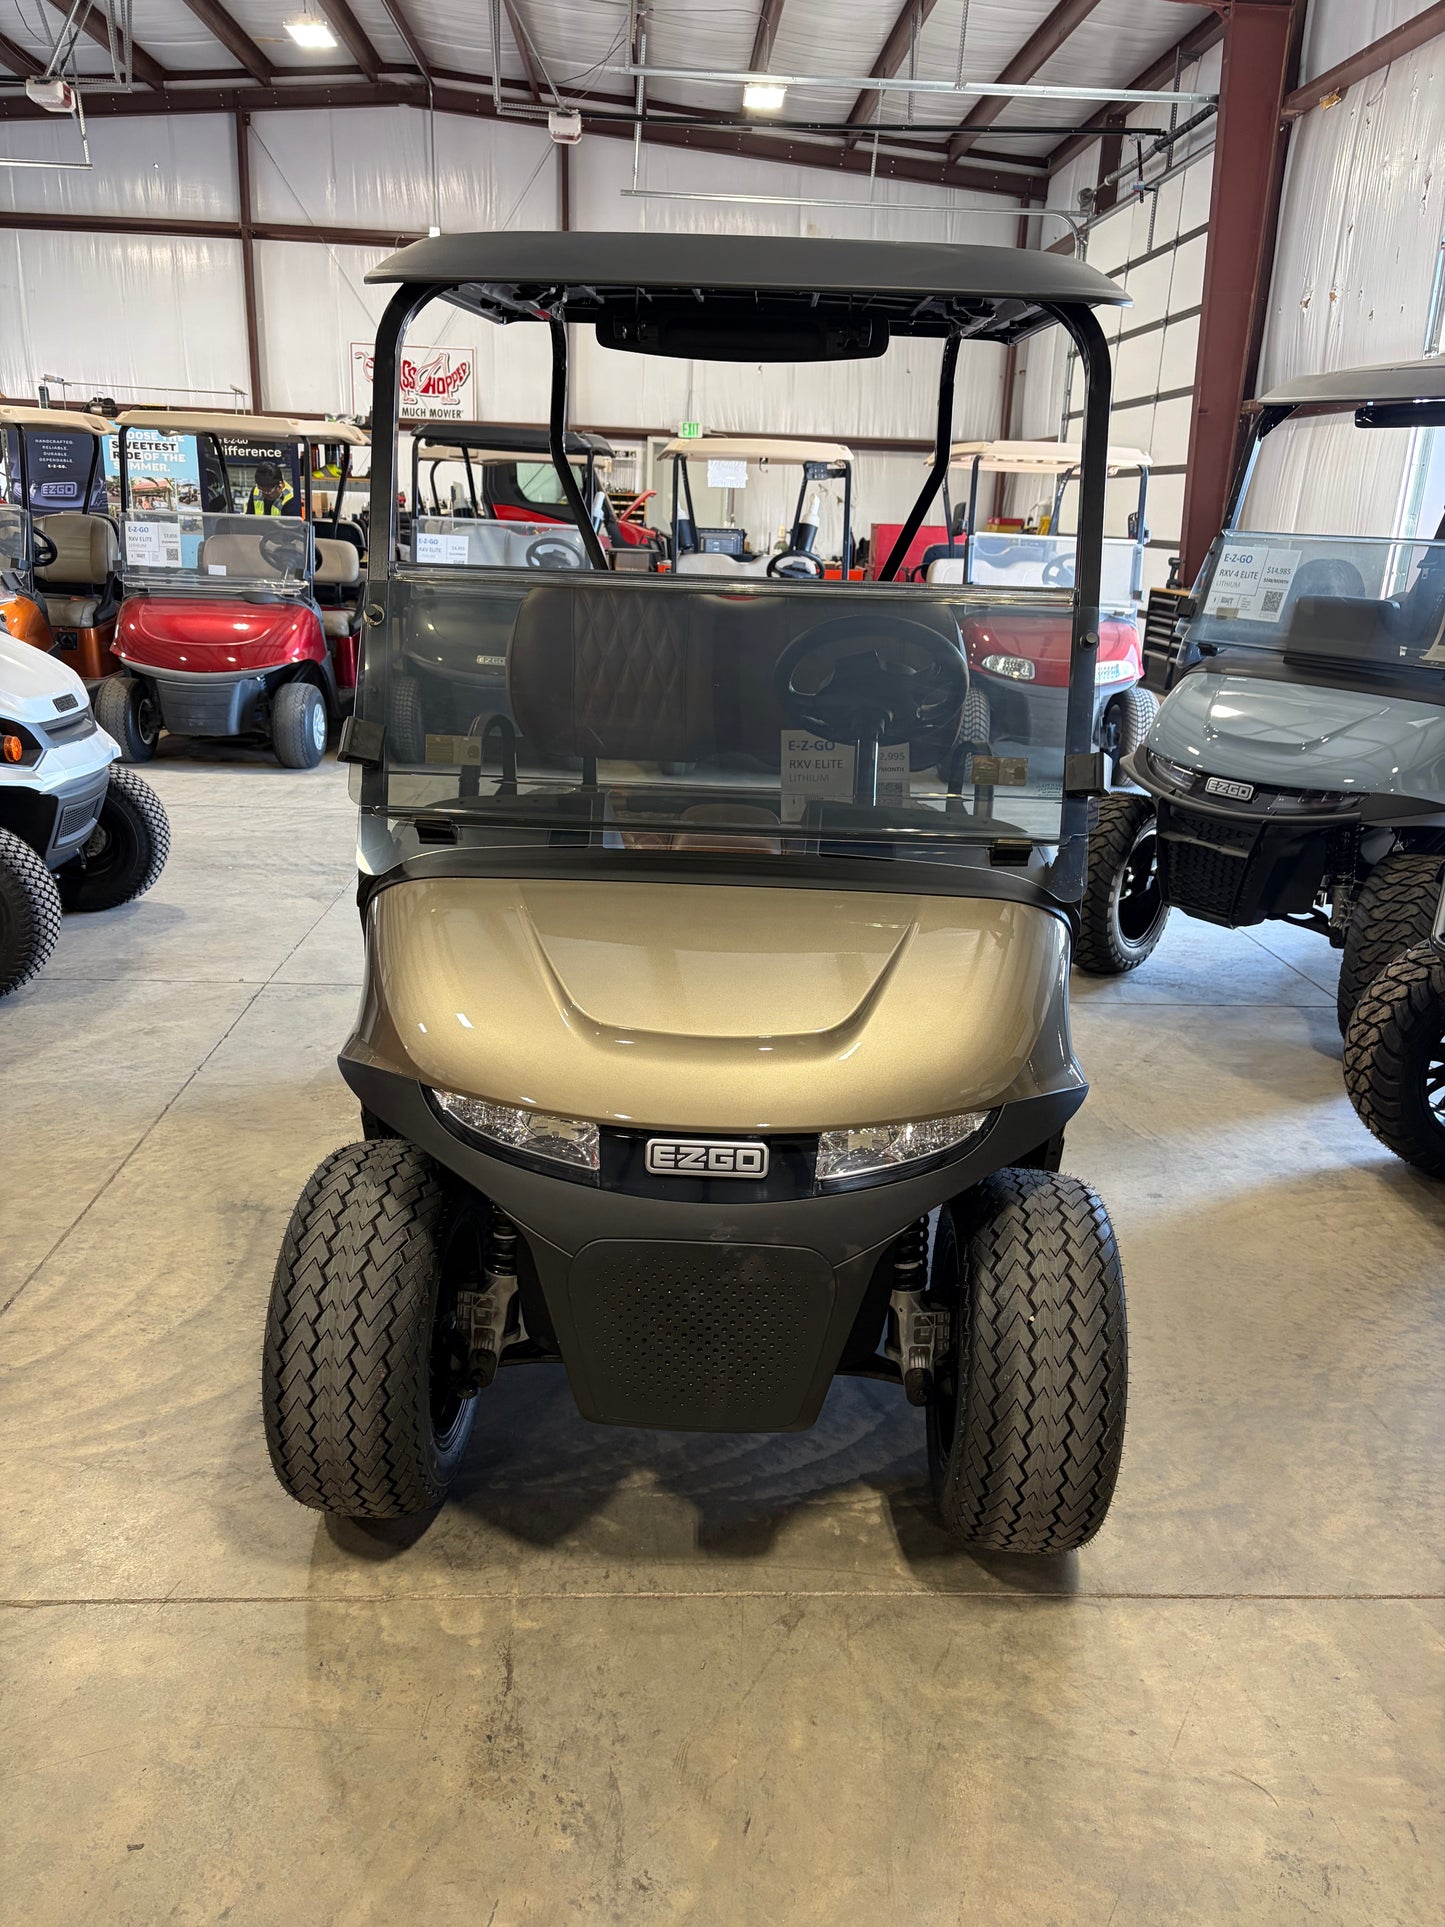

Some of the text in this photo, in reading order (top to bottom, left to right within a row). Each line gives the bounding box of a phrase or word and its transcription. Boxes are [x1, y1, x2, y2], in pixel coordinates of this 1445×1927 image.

[402, 408, 461, 418] MUCH MOWER
[682, 422, 700, 436] EXIT
[113, 451, 186, 463] RDE OF THE
[214, 445, 282, 458] ifference
[113, 462, 171, 472] SMMER.
[1223, 553, 1254, 564] E-Z-GO
[1219, 568, 1233, 577] RXV
[1216, 580, 1241, 588] LITHIUM
[788, 740, 836, 751] E-Z-GO
[789, 759, 812, 769] RXV
[1208, 780, 1250, 797] EZGO
